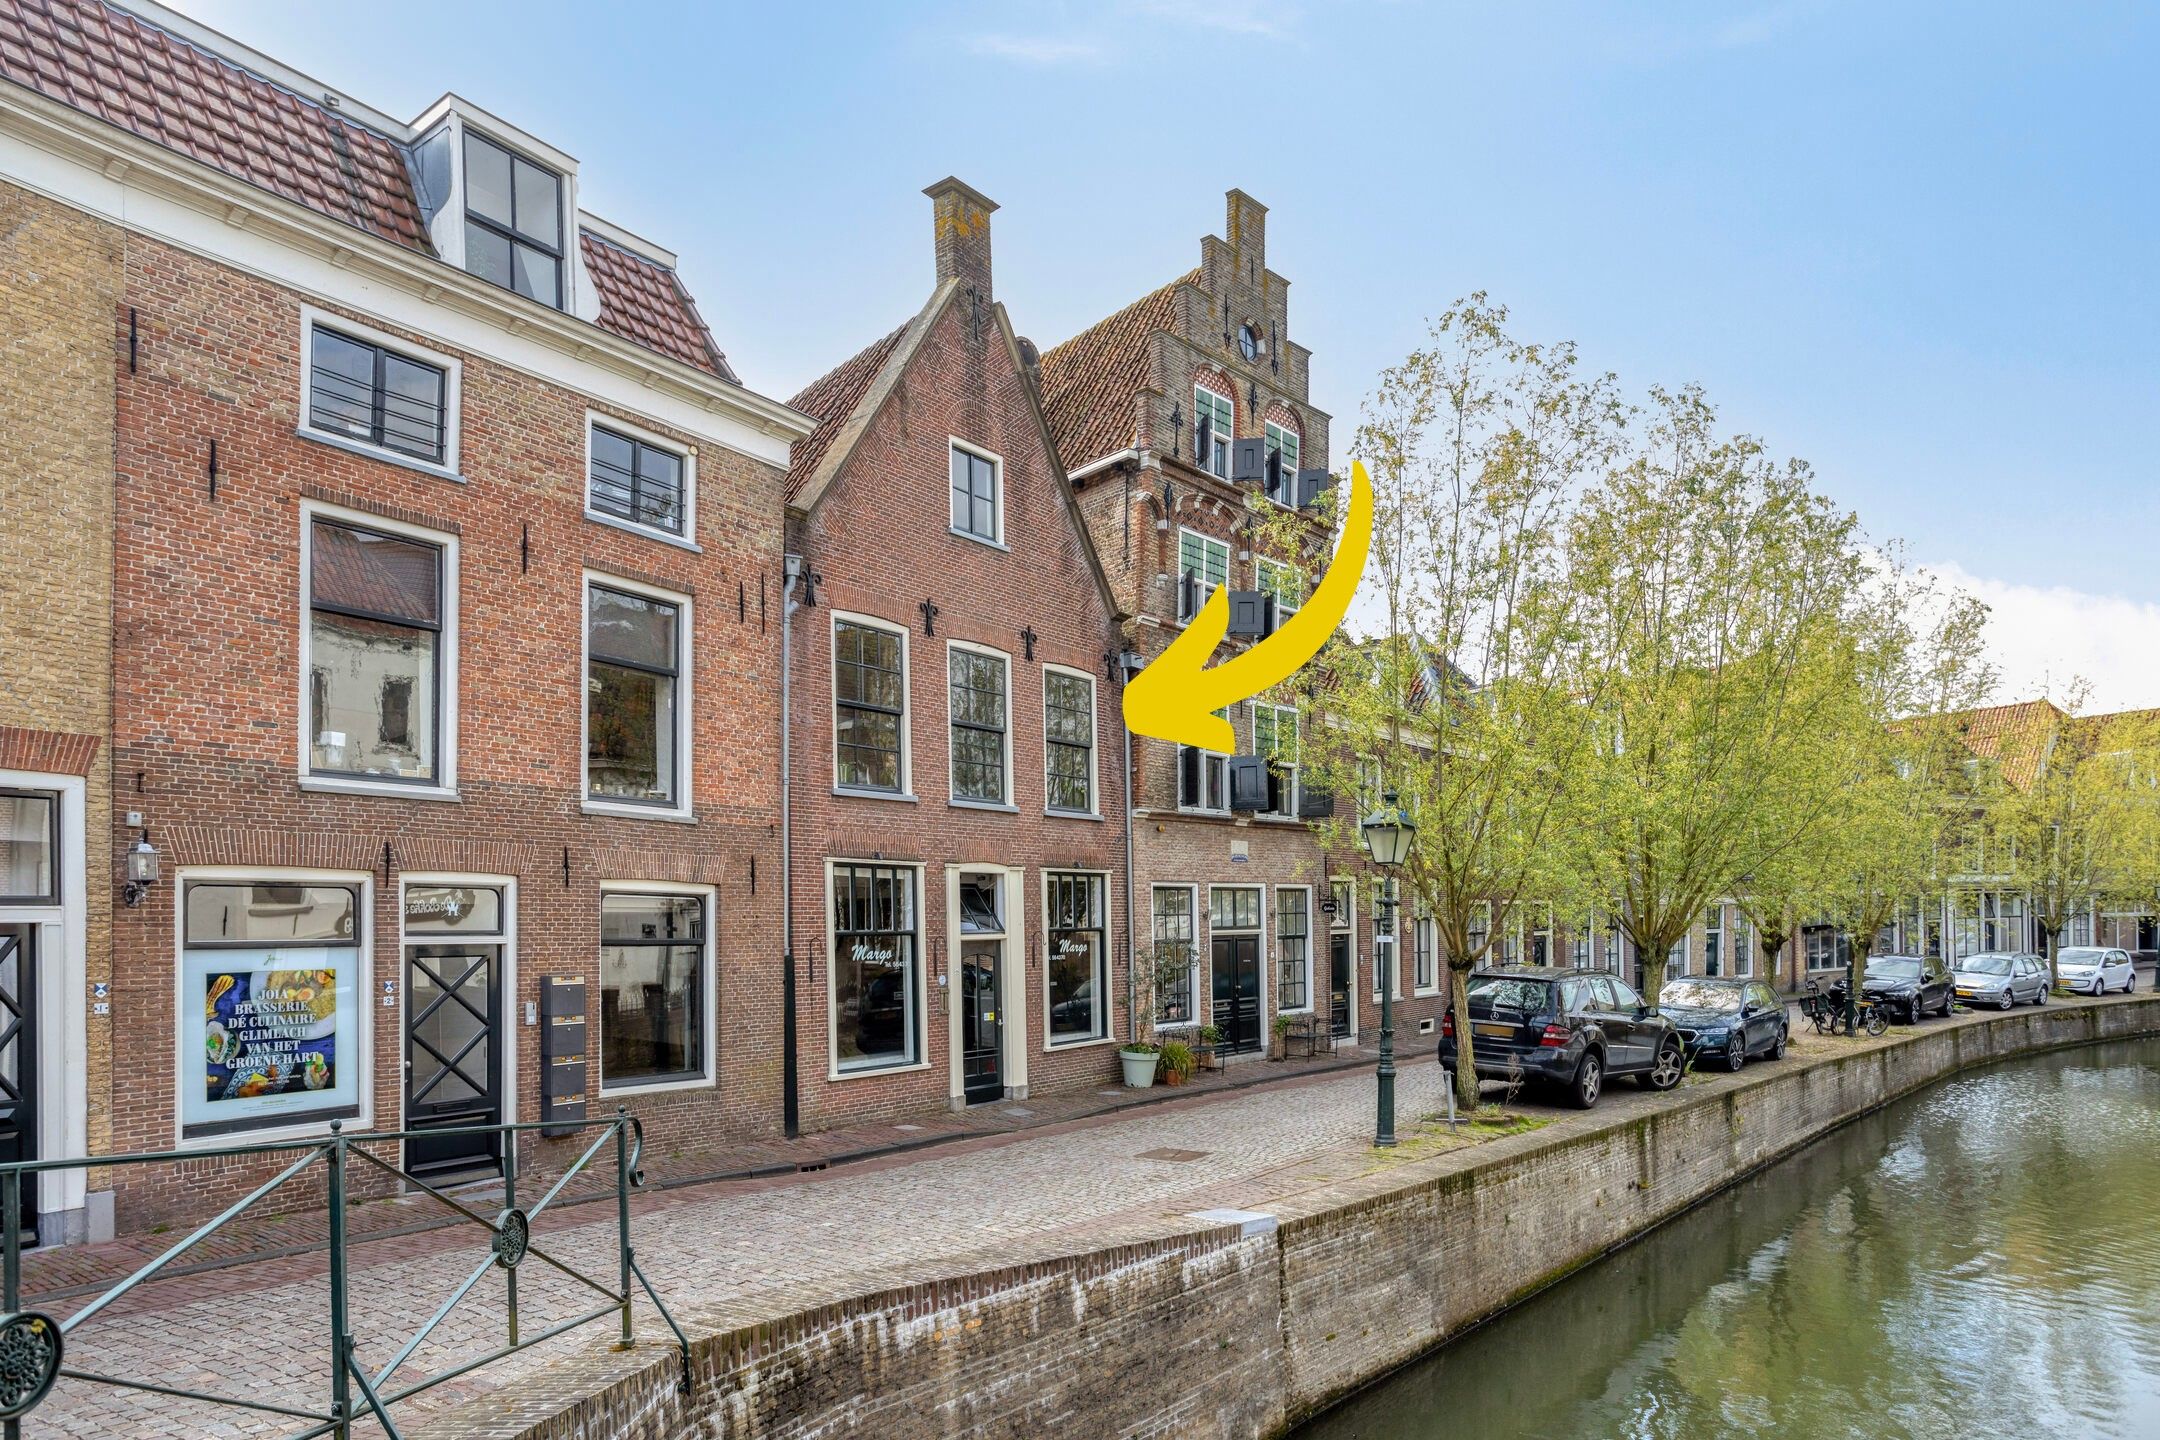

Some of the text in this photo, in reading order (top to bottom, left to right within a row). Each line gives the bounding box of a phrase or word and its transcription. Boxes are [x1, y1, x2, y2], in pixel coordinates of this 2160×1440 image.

[851, 944, 893, 965] Margo
[1059, 939, 1088, 956] Margo
[258, 989, 289, 1000] JOIA
[228, 1013, 317, 1029] DÉ CULINAIRE
[239, 1027, 306, 1041] GLIMLACH
[246, 1040, 301, 1054] VAN HET
[225, 1052, 319, 1069] GROENE HART
